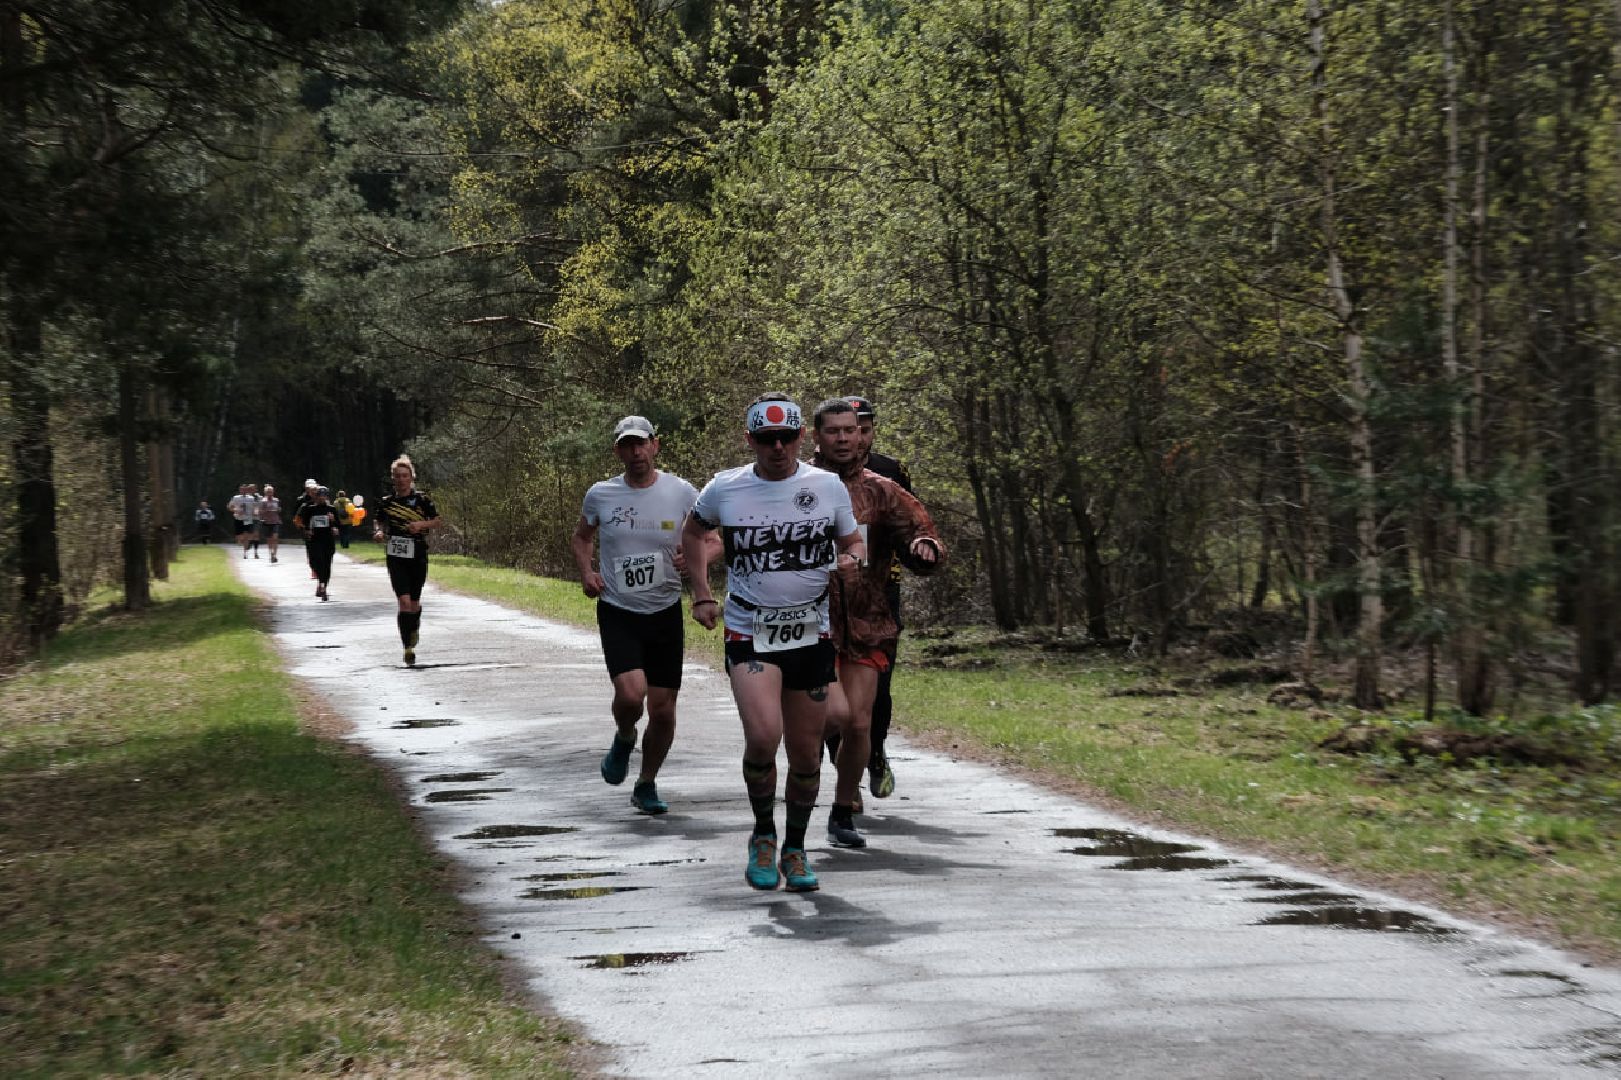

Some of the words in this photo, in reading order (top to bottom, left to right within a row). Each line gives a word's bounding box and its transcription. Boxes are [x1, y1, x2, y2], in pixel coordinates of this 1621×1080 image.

[733, 519, 829, 550] NEVER
[625, 564, 655, 587] 807
[780, 609, 807, 621] asics
[766, 623, 805, 645] 760
